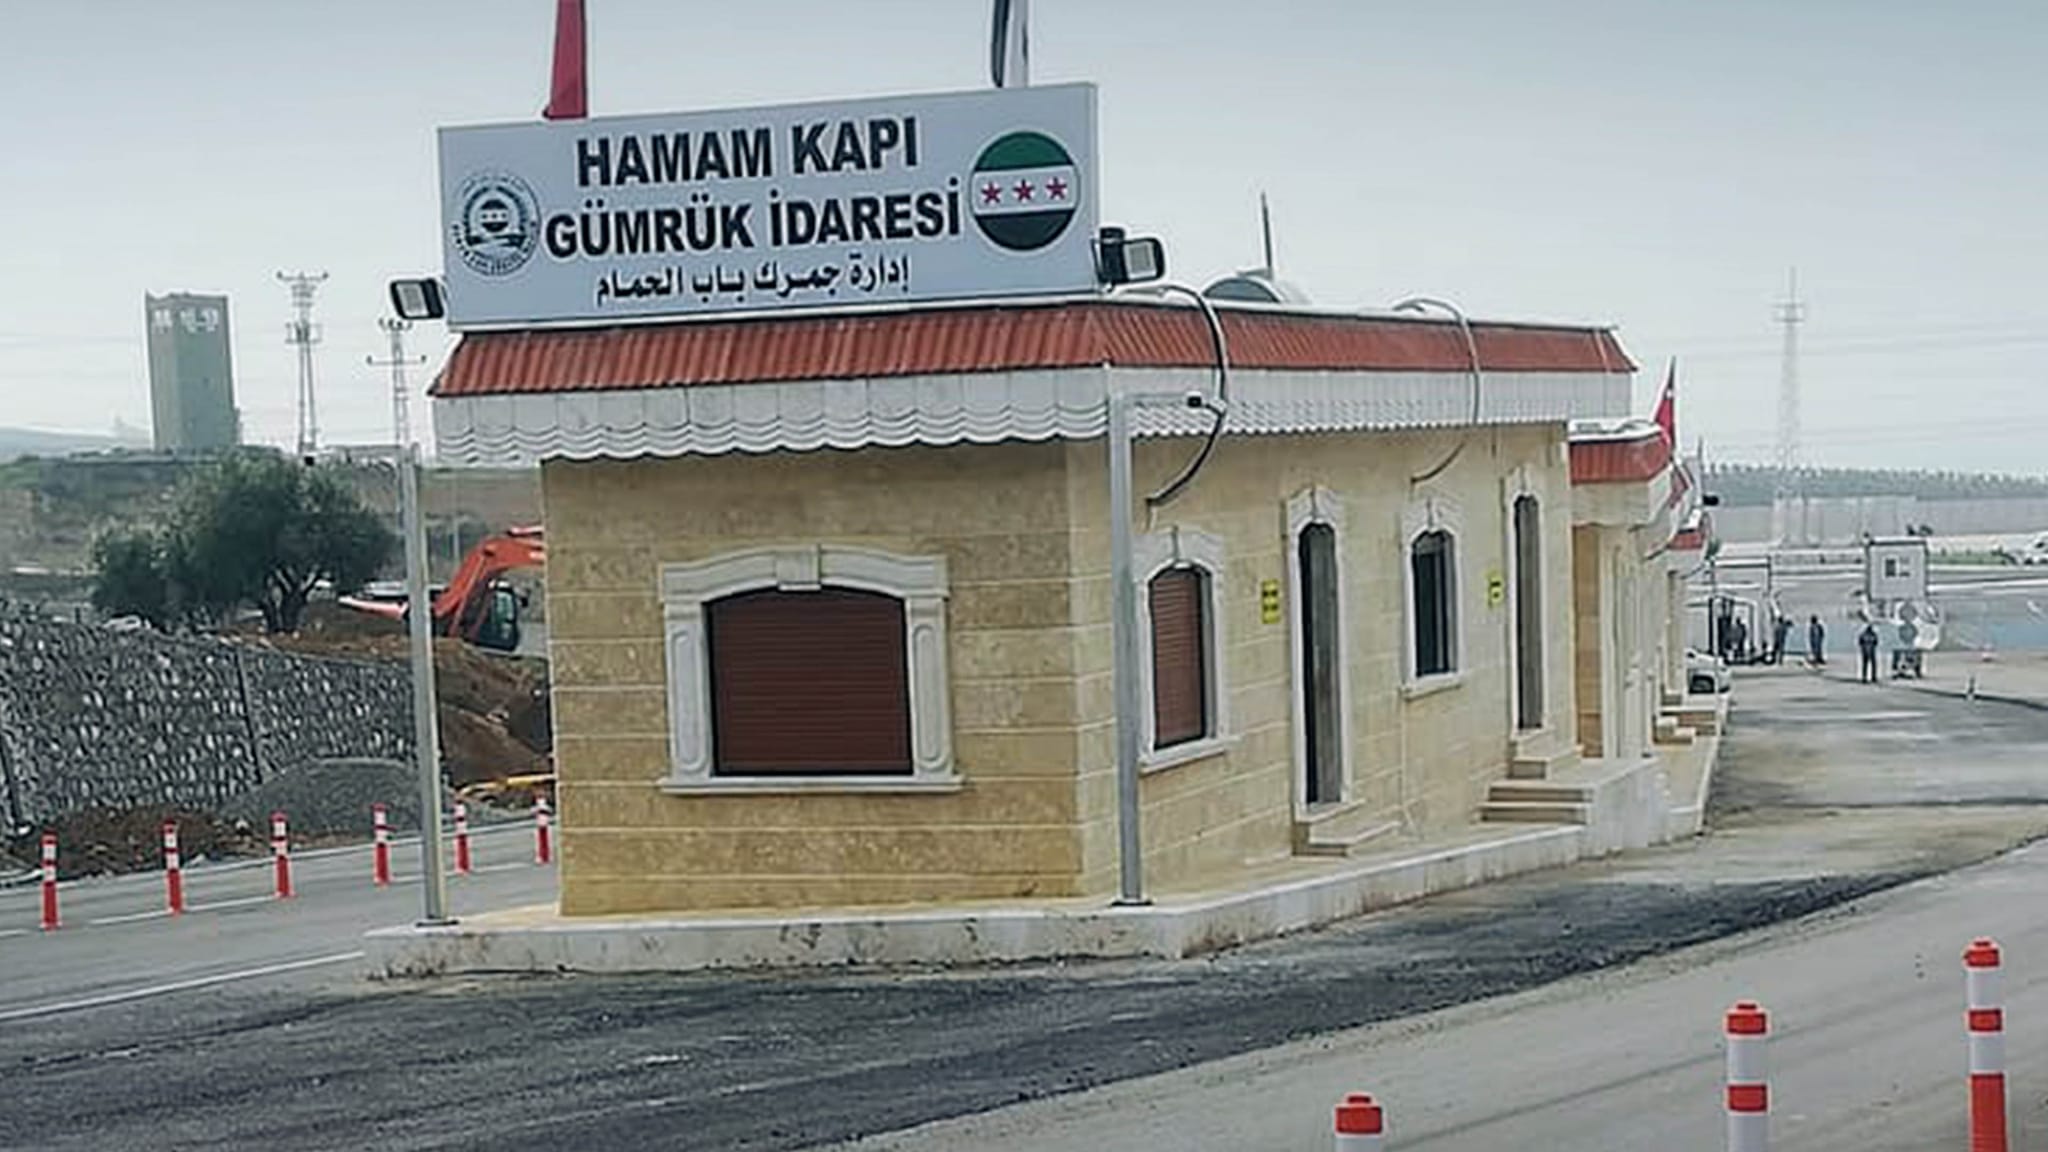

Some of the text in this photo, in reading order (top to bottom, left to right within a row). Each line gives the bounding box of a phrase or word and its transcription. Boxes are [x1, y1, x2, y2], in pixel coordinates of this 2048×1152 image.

[576, 116, 918, 188] HAMAM KAPI
[546, 193, 755, 258] GÜMRÜK
[770, 177, 961, 247] İDARESİ
[596, 252, 909, 307] إدارة جمرك باب الحمام
